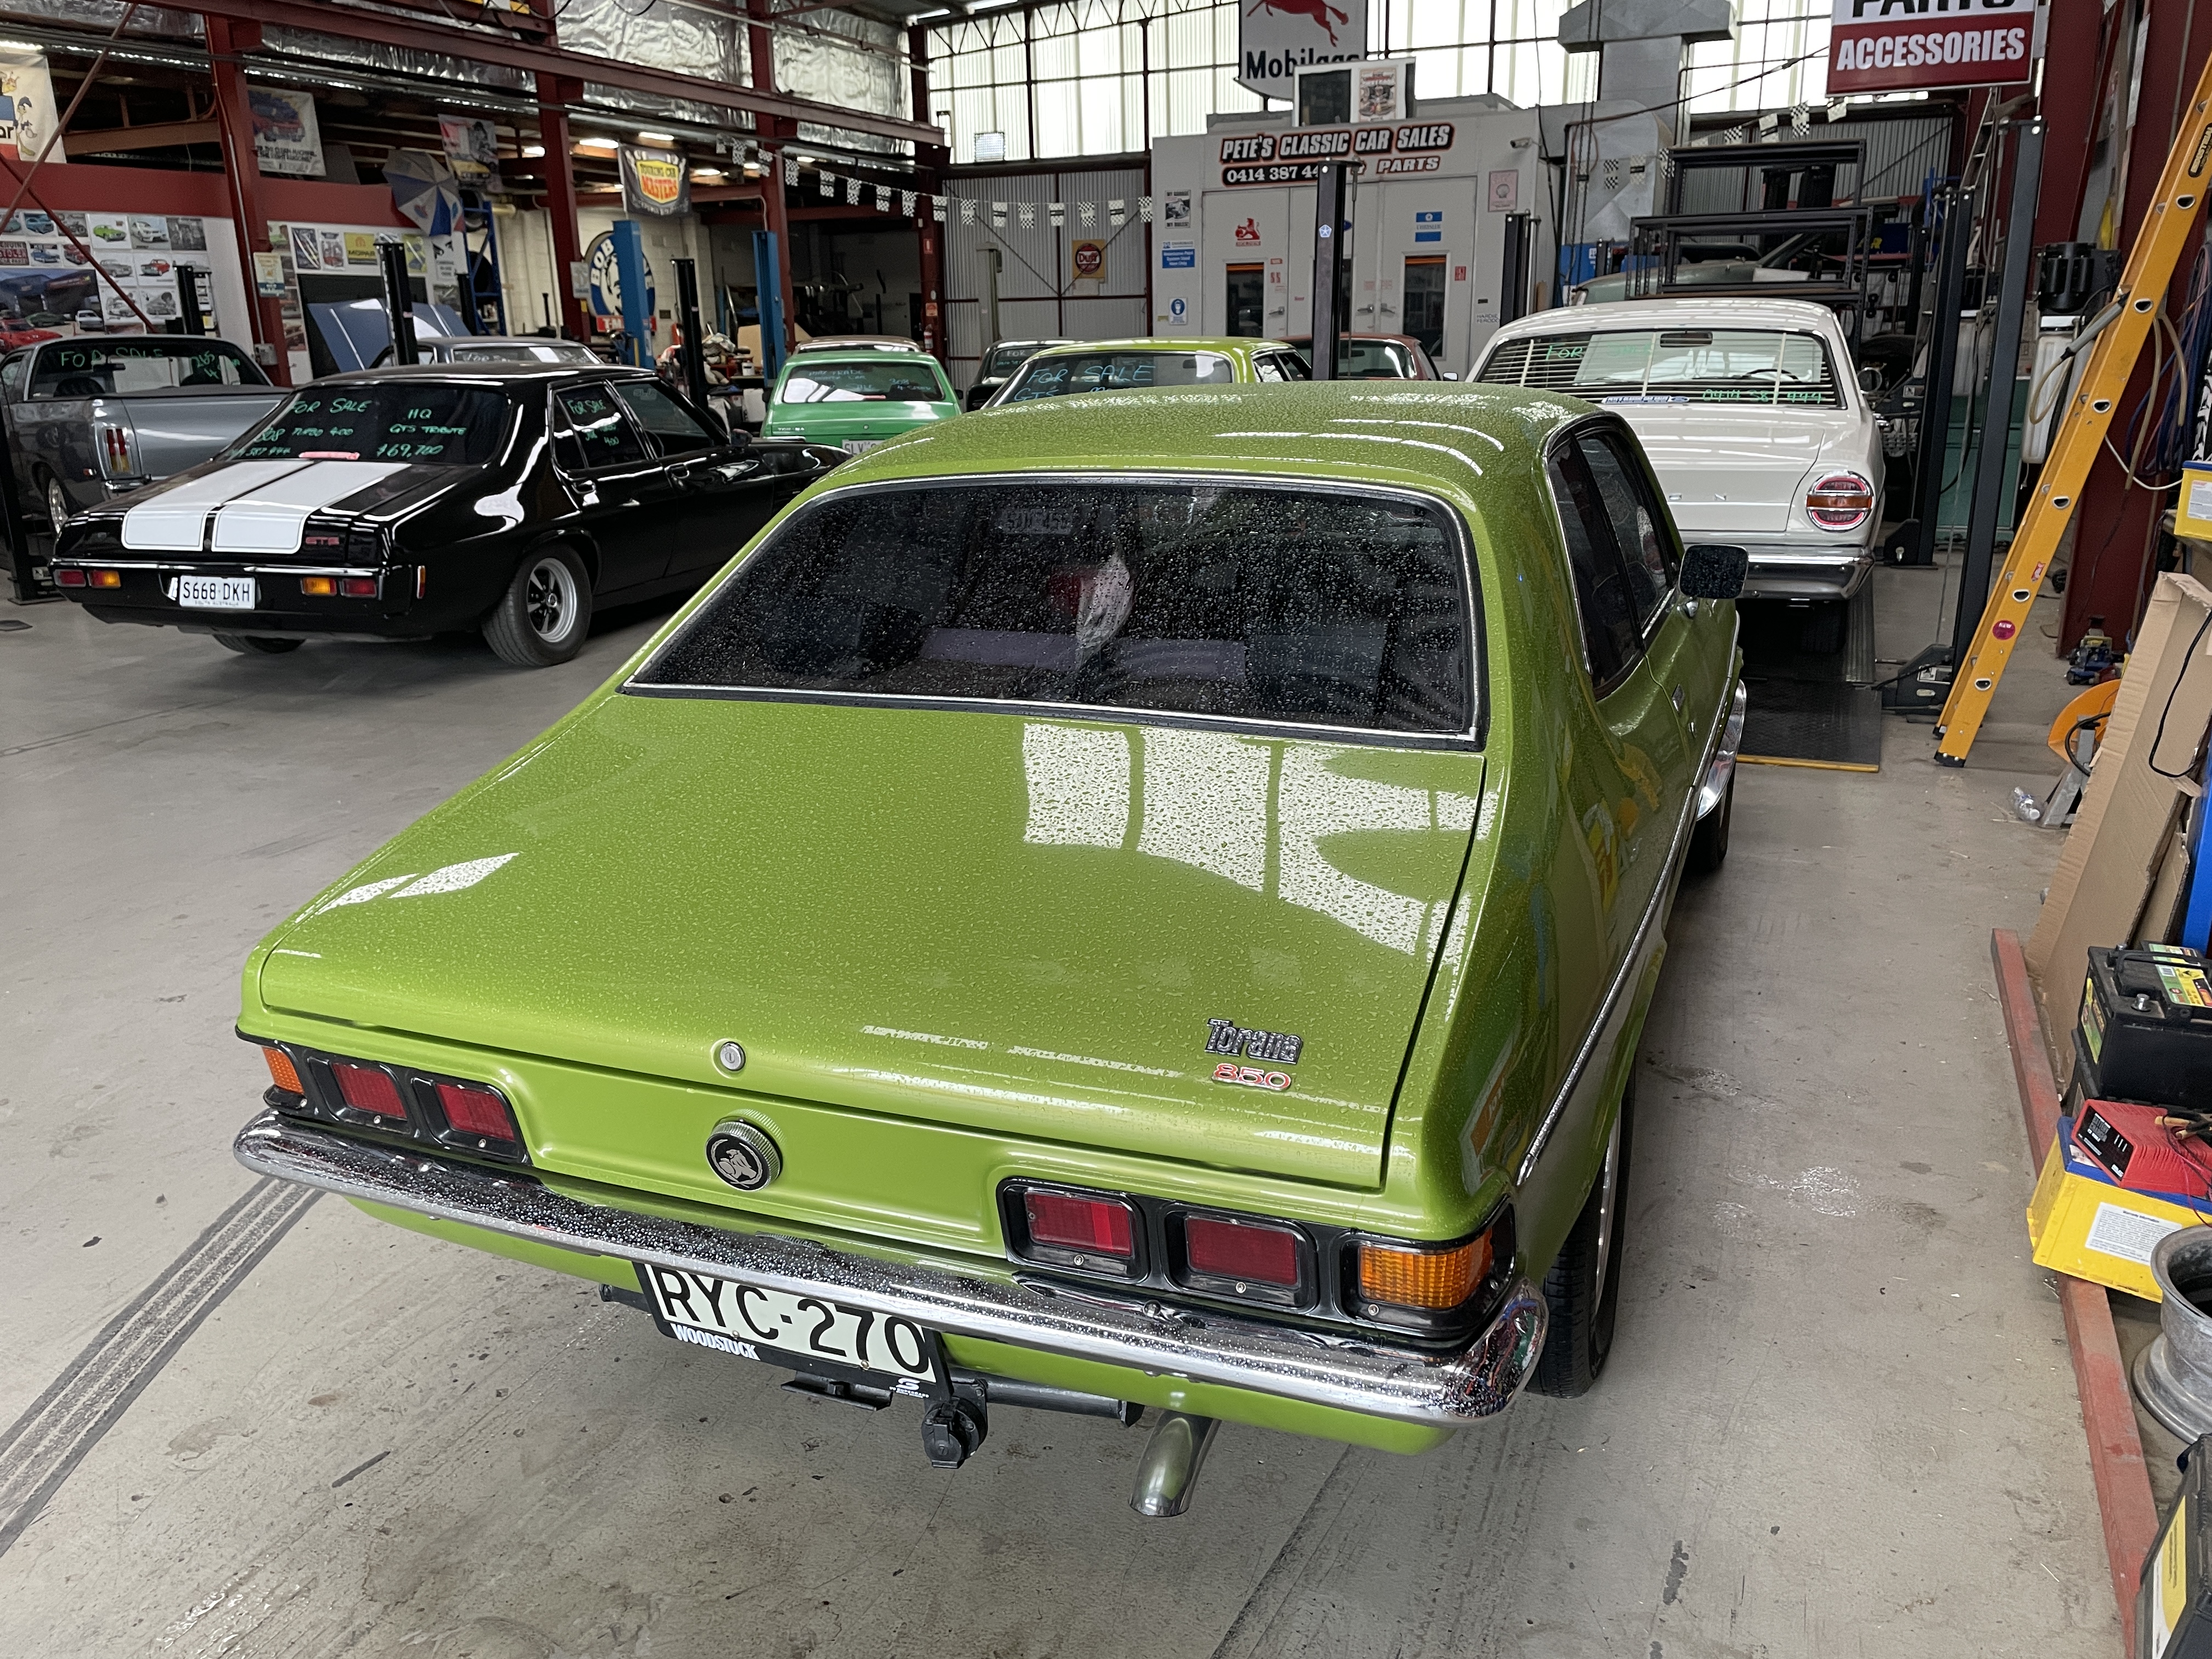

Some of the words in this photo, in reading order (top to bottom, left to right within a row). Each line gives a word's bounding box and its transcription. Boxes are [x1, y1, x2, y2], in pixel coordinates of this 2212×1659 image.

[1836, 27, 2025, 71] ACCESSORIES
[1246, 48, 1359, 79] Mobil
[1222, 135, 1273, 160] PETE'S
[1280, 132, 1350, 156] CLASSIC
[1355, 129, 1390, 151] CAR
[1397, 125, 1450, 148] SALES
[1378, 156, 1440, 173] PARTS
[1227, 168, 1265, 183] 0414
[1269, 166, 1298, 180] 387
[1302, 165, 1318, 178] 44
[1545, 343, 1585, 361] FOR
[1026, 369, 1068, 383] FOR
[1084, 364, 1155, 382] SALE
[330, 398, 372, 413] SALE
[1747, 390, 1778, 403] 38
[567, 399, 587, 414] FOR
[585, 399, 606, 413] SALE
[390, 424, 416, 433] GTS
[306, 537, 339, 545] GTS
[183, 582, 216, 599] S668
[223, 583, 250, 602] DKH
[1205, 1018, 1304, 1065] Torana
[1211, 1063, 1292, 1091] 850
[670, 1323, 761, 1361] WOODSTOCK
